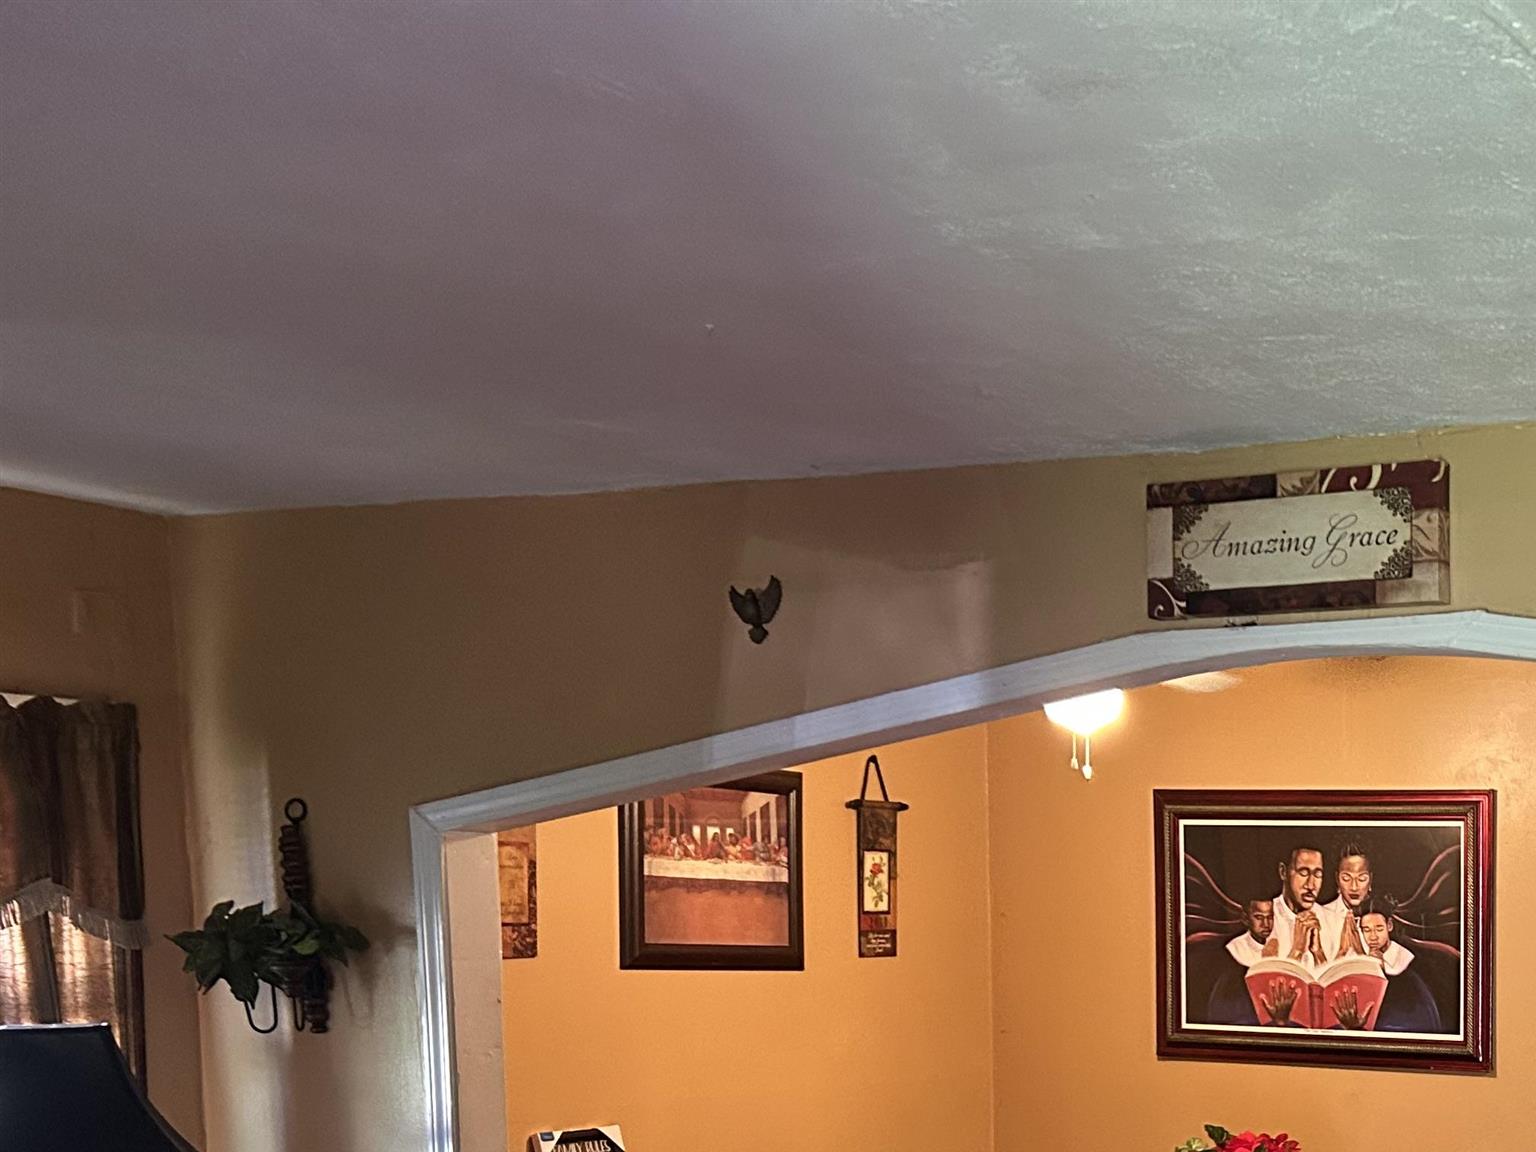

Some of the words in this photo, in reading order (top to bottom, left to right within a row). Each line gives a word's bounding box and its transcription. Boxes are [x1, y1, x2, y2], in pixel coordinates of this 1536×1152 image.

[1181, 520, 1316, 560] Amazing
[1312, 513, 1399, 569] Grace
[584, 1140, 611, 1152] RULES
